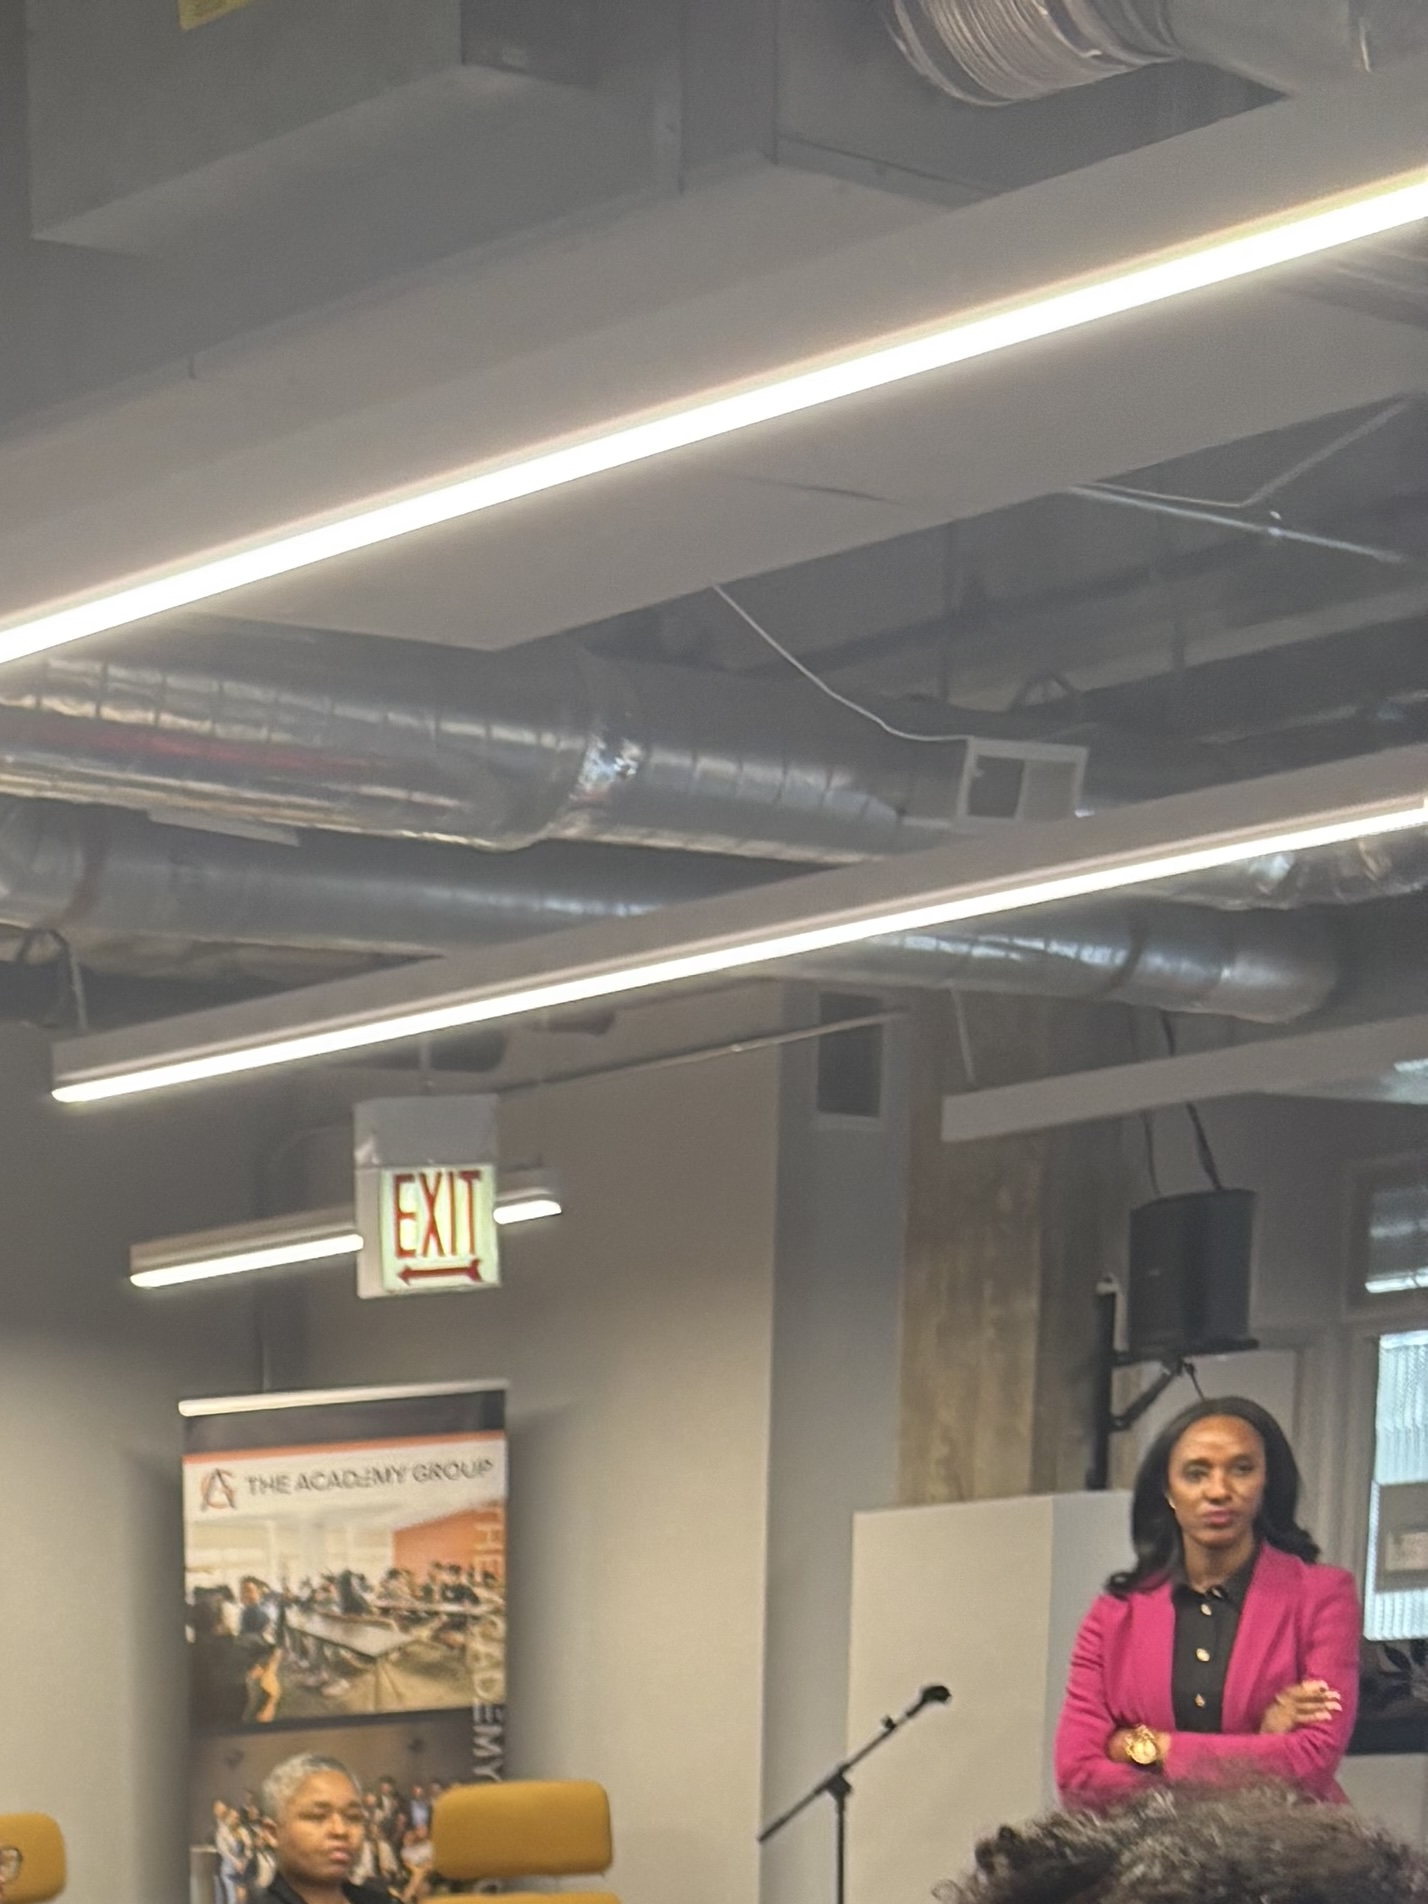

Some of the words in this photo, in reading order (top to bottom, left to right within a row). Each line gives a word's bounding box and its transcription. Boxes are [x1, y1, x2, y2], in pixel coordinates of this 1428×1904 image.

[393, 1170, 482, 1258] EXIT
[245, 1474, 293, 1497] THE
[296, 1466, 408, 1492] ACADEMY
[411, 1459, 494, 1484] GROUP
